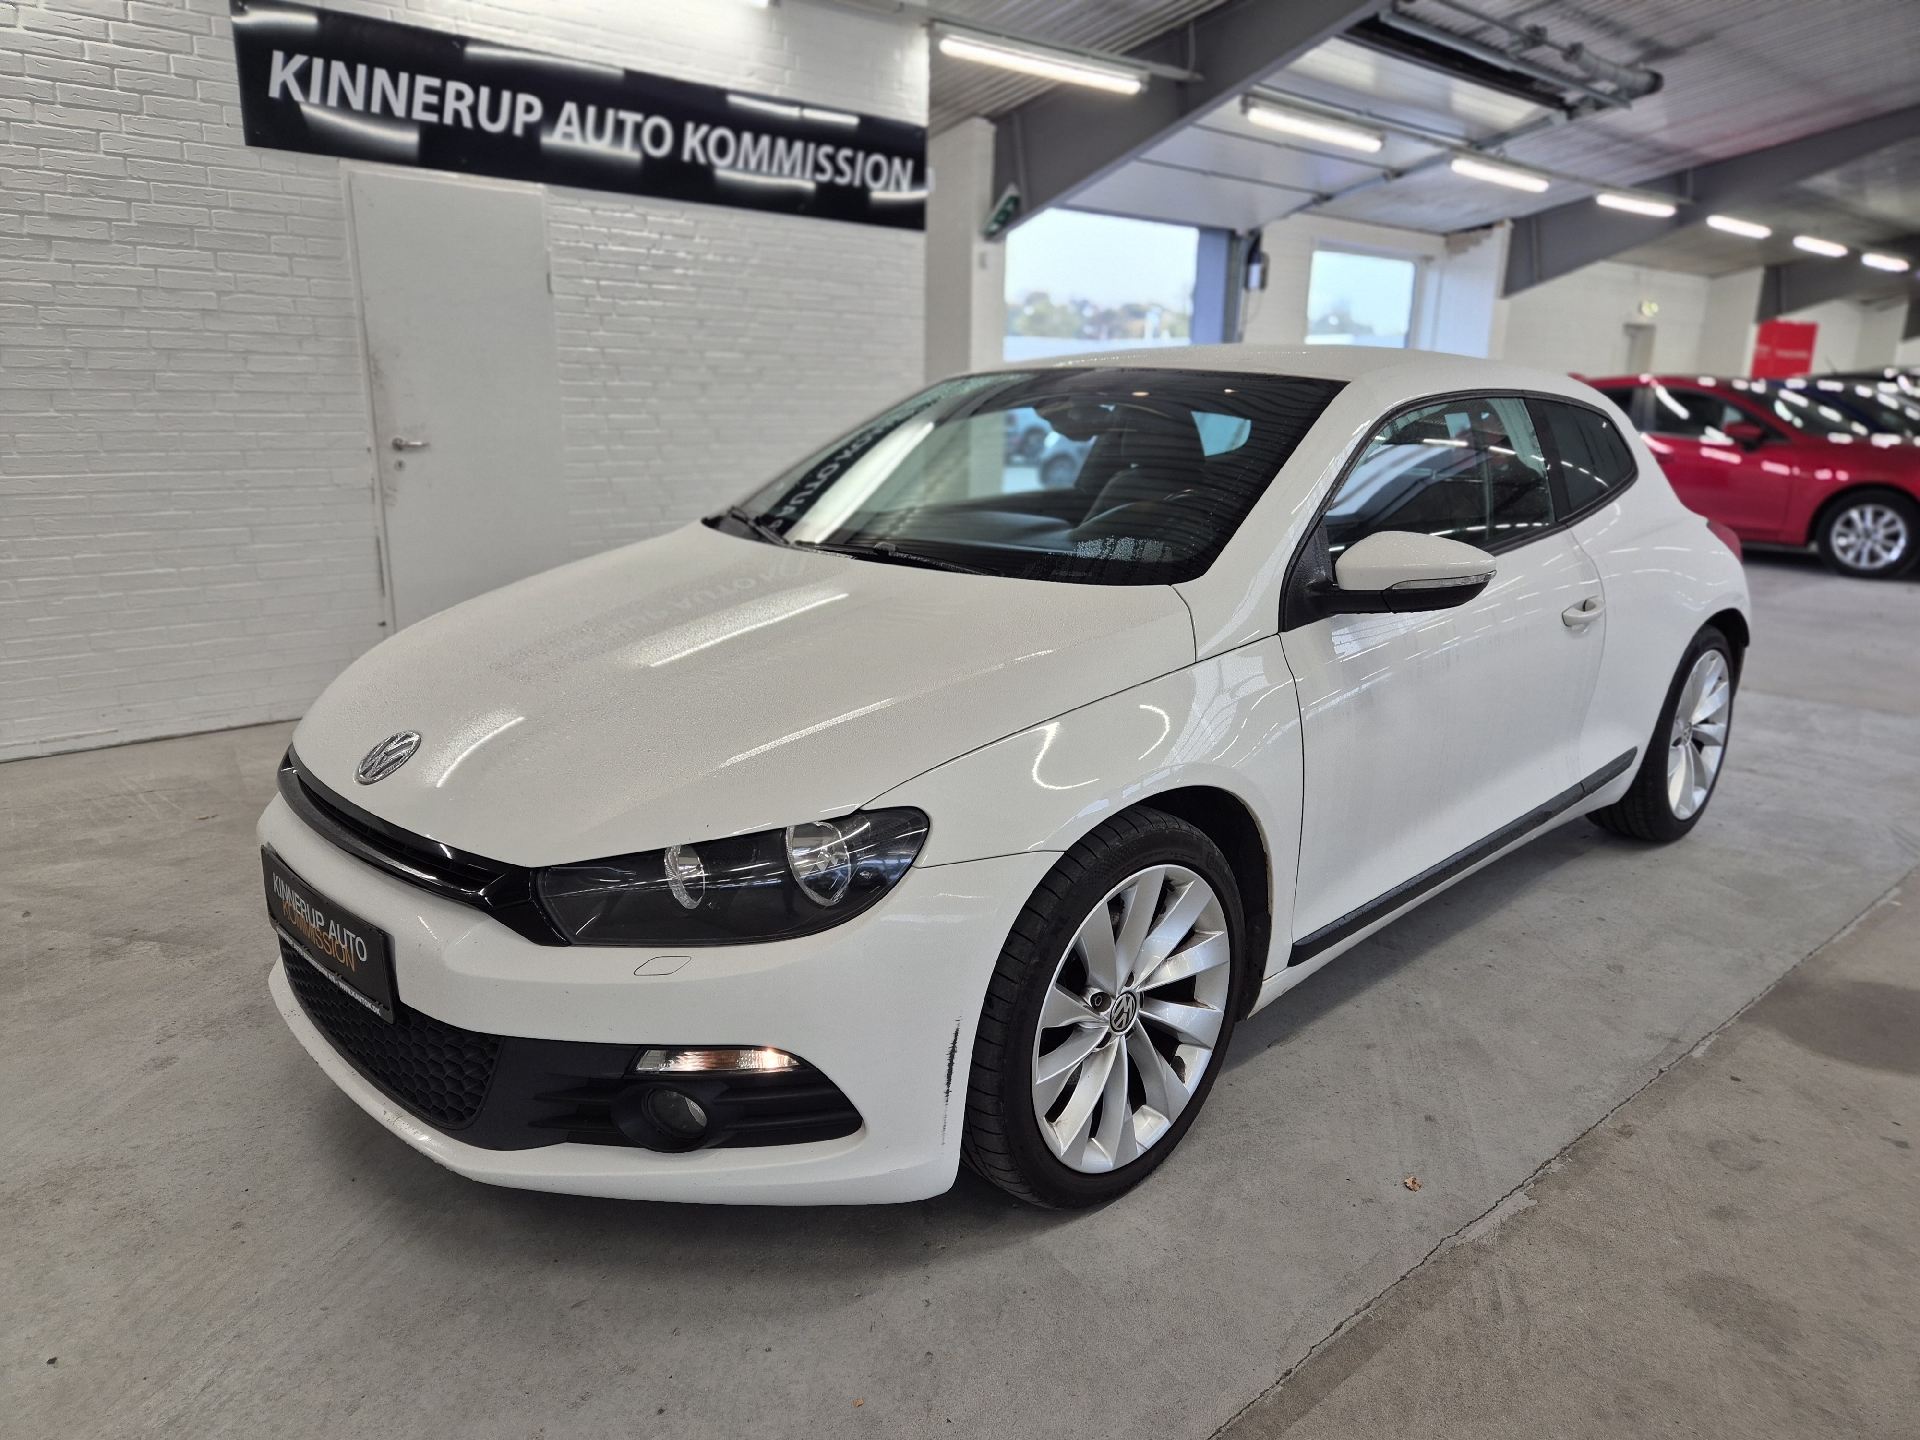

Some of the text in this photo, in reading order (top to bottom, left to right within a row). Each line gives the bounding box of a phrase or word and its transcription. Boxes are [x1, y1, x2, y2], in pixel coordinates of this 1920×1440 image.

[268, 49, 913, 192] KINNERUP AUTO KOMMISSION
[273, 872, 324, 928] KINNERUP
[328, 920, 367, 961] AUTO
[282, 898, 355, 971] KOMMISSION
